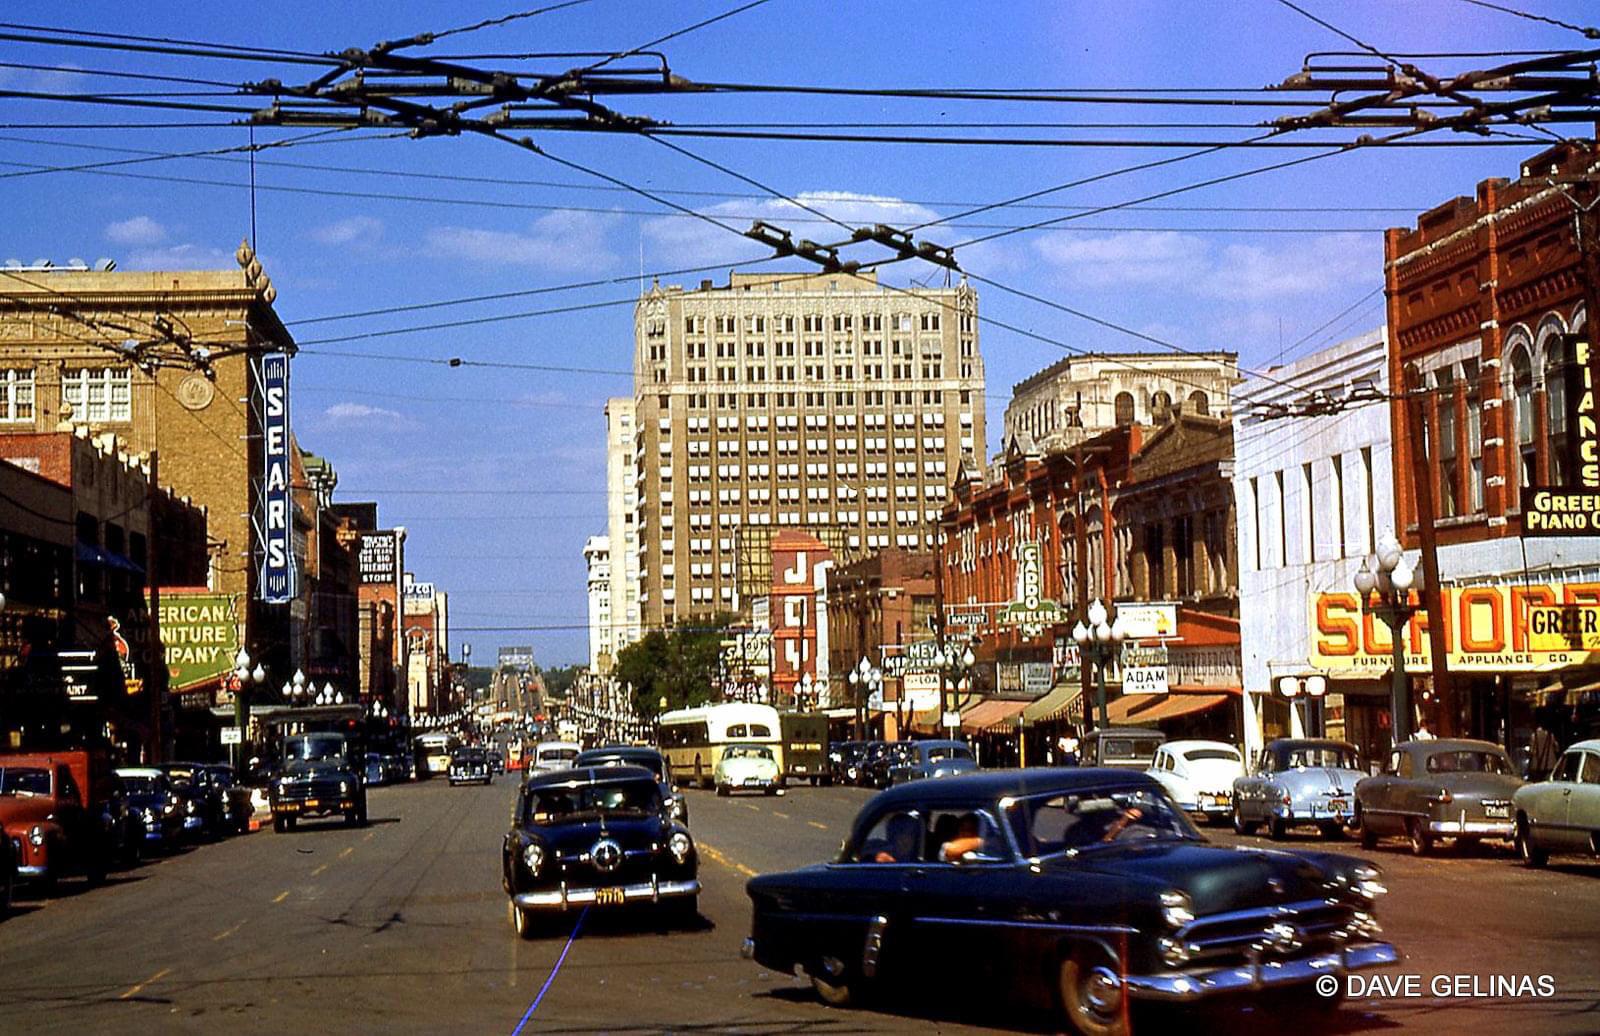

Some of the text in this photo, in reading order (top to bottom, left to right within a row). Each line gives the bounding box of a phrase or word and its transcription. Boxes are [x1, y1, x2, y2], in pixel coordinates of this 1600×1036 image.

[266, 387, 285, 569] SEARS
[1534, 492, 1600, 512] GREE
[1527, 511, 1587, 530] PIANO
[1023, 547, 1039, 610] CADDO
[127, 606, 225, 623] AERICAN
[1003, 611, 1061, 622] JEWELERS
[127, 626, 227, 644] FUNITURE
[909, 643, 960, 659] MEYR'S
[1353, 654, 1573, 666] FURNIURE APPLIANCE CO.
[1126, 670, 1165, 683] ADAM
